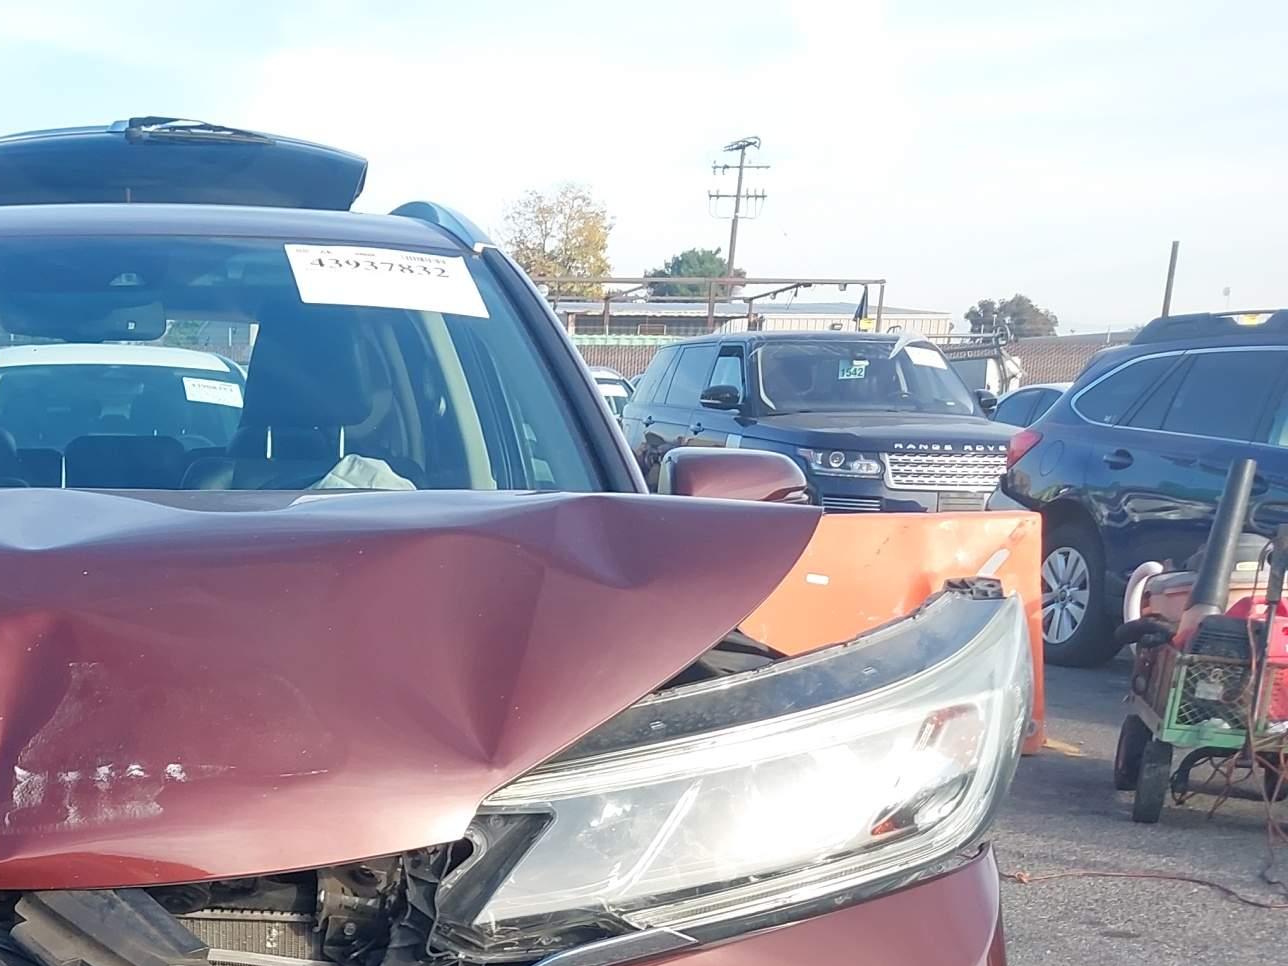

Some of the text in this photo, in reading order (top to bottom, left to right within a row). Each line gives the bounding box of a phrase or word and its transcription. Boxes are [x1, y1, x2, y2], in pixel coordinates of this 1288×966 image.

[310, 257, 449, 278] 43937832
[840, 367, 863, 377] 1542
[894, 442, 952, 451] RANGE
